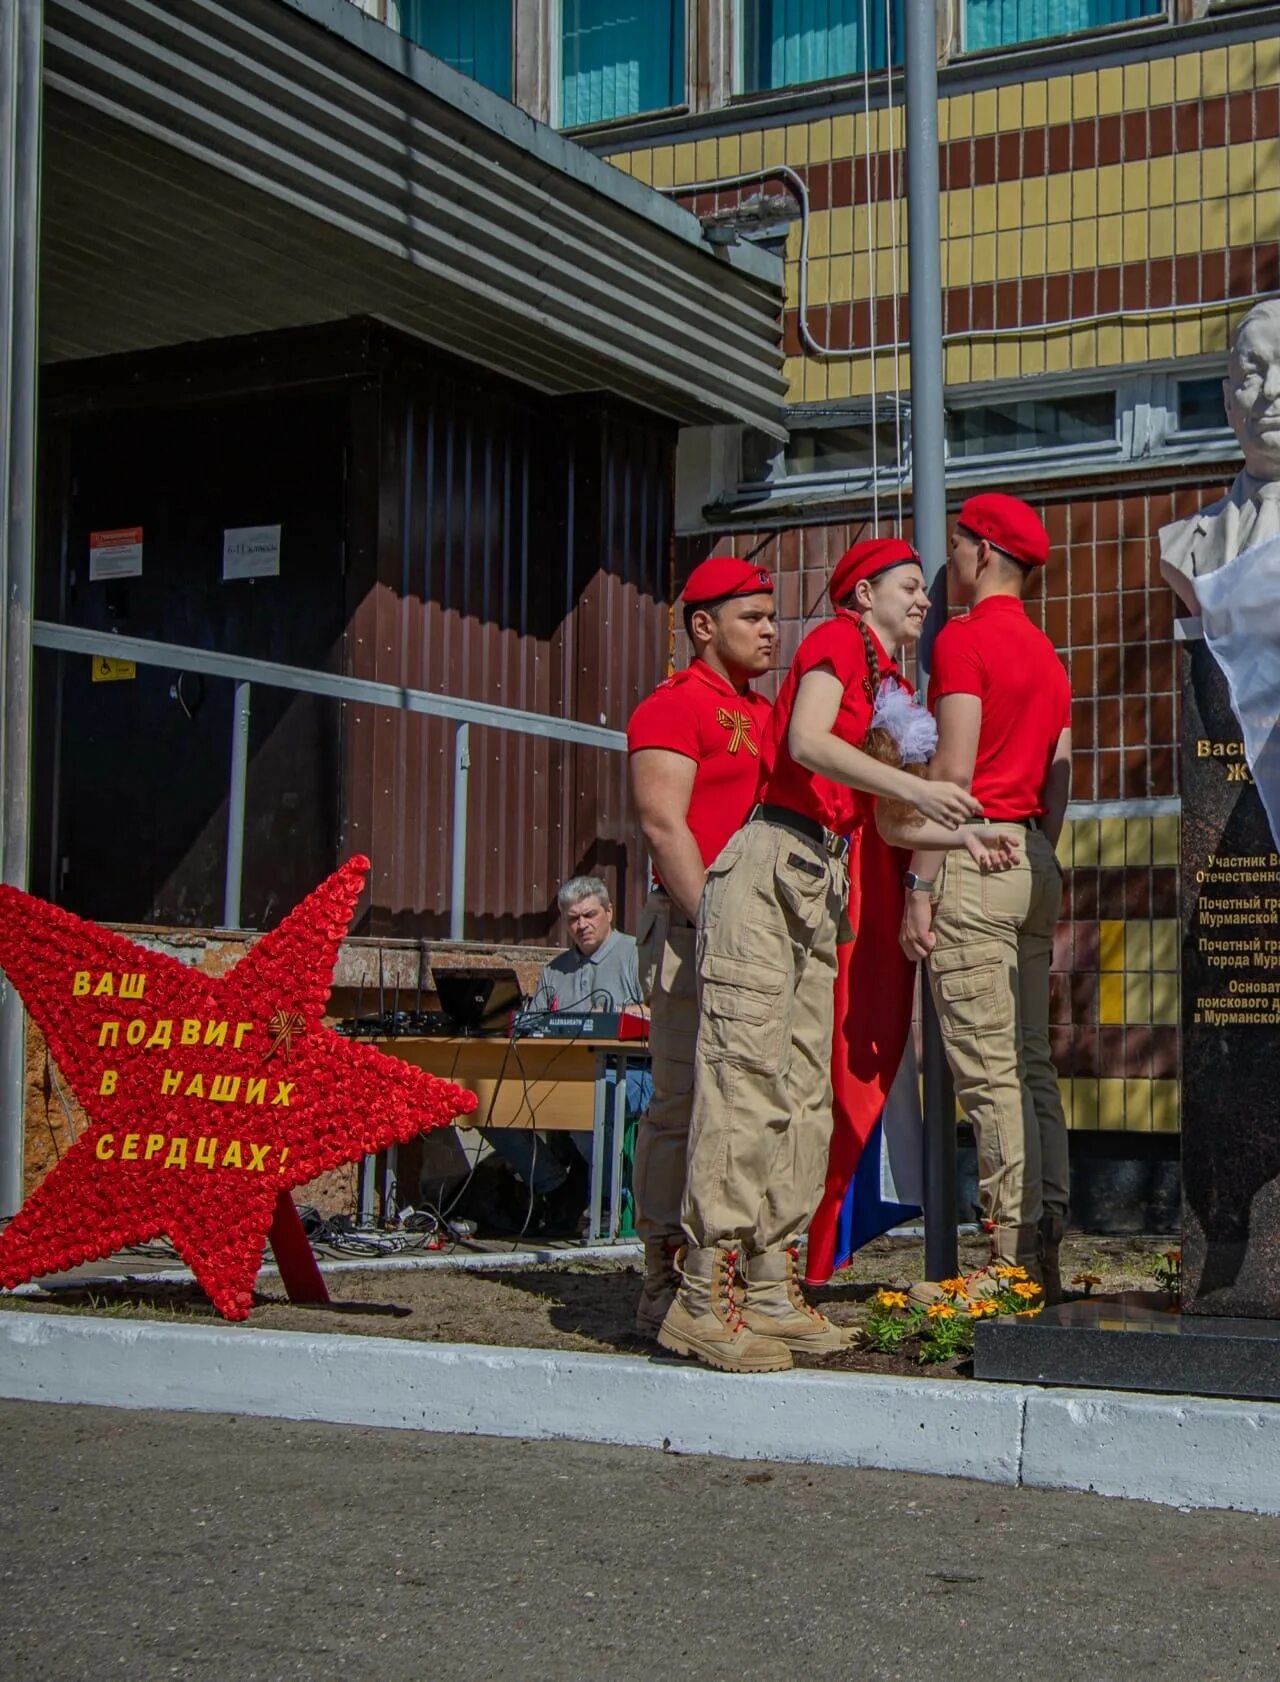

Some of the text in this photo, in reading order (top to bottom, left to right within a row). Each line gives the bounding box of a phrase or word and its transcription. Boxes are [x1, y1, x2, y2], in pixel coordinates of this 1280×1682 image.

[1226, 762, 1254, 785] Ж
[1208, 854, 1266, 868] Участник
[1199, 895, 1260, 910] Почетный
[1199, 911, 1278, 927] Мурманской
[1198, 937, 1261, 951] Почетный
[1208, 956, 1250, 969] города
[72, 970, 146, 999] ВАШ
[1197, 997, 1269, 1009] поискового
[1193, 1012, 1201, 1024] в
[98, 1019, 253, 1050] ПОДВИГ
[99, 1069, 295, 1107] В НАШИХ
[95, 1133, 288, 1175] СЕРДЦАХ!
